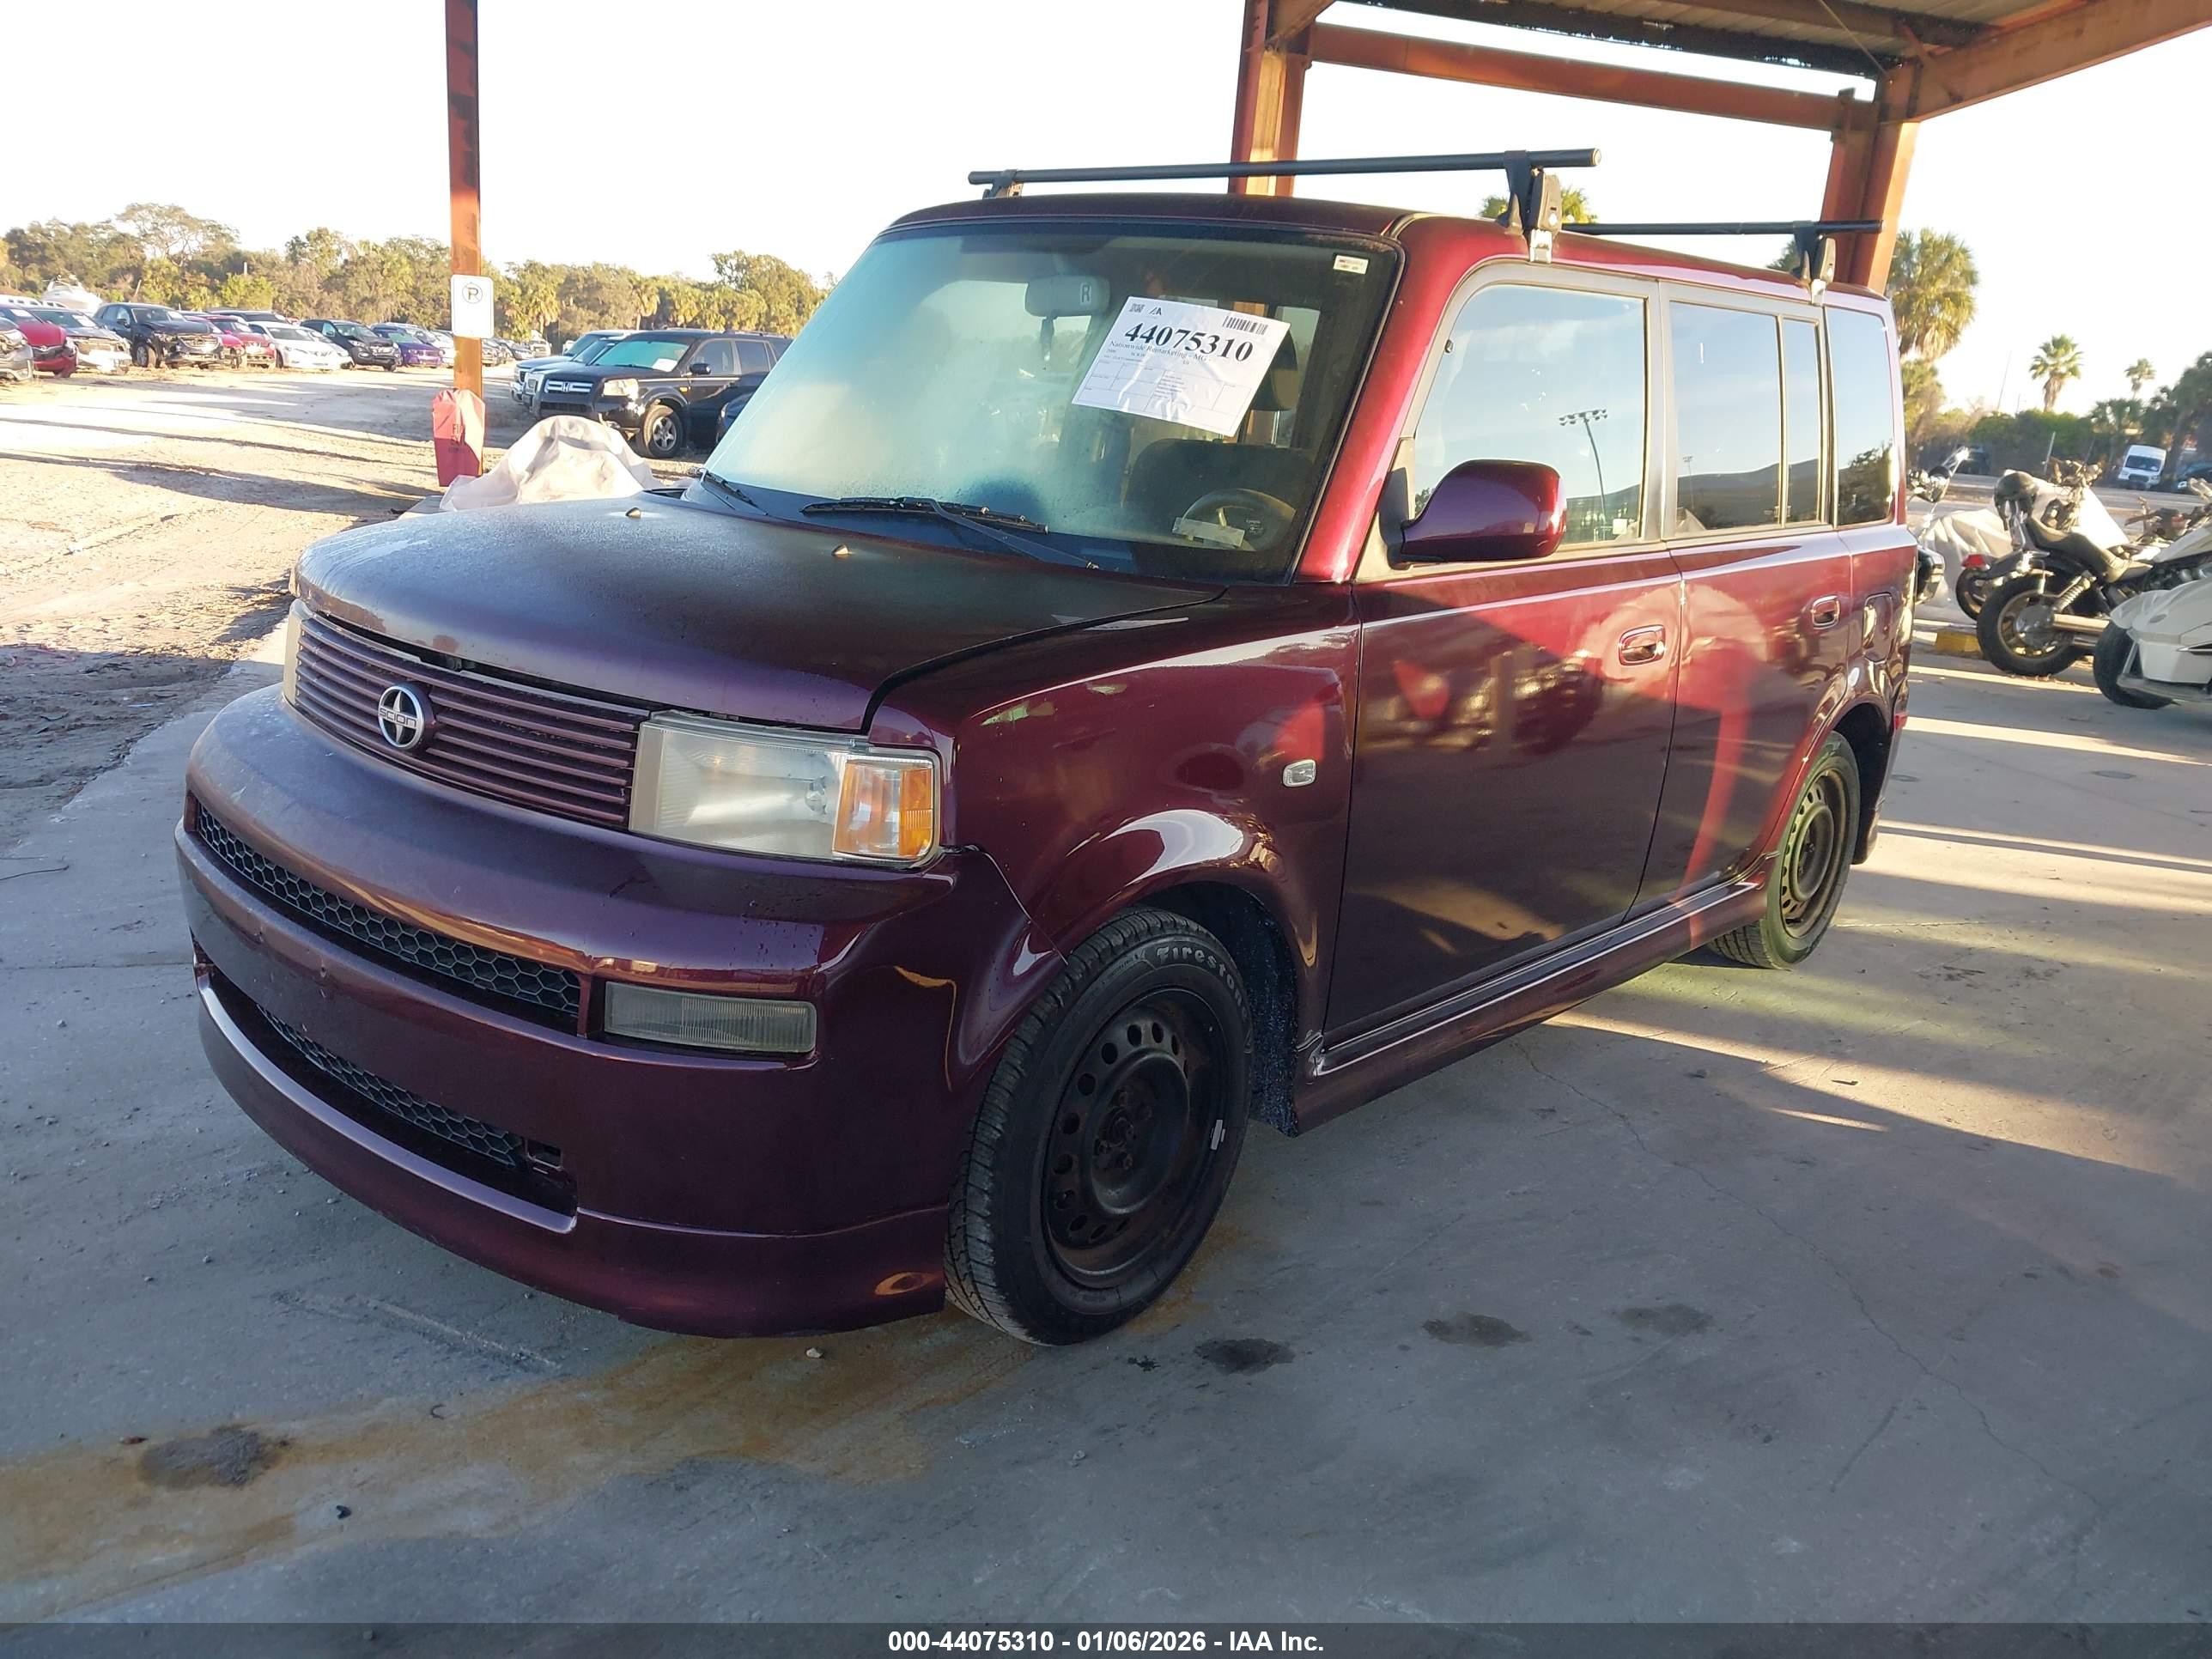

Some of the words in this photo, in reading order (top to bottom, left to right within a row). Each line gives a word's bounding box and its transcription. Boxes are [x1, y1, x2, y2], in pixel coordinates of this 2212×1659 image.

[1110, 340, 1146, 351] Nationwide
[1146, 344, 1187, 359] Remarketing
[1125, 322, 1254, 362] 44075310
[380, 708, 417, 728] SCION
[1157, 945, 1248, 1020] Firestone
